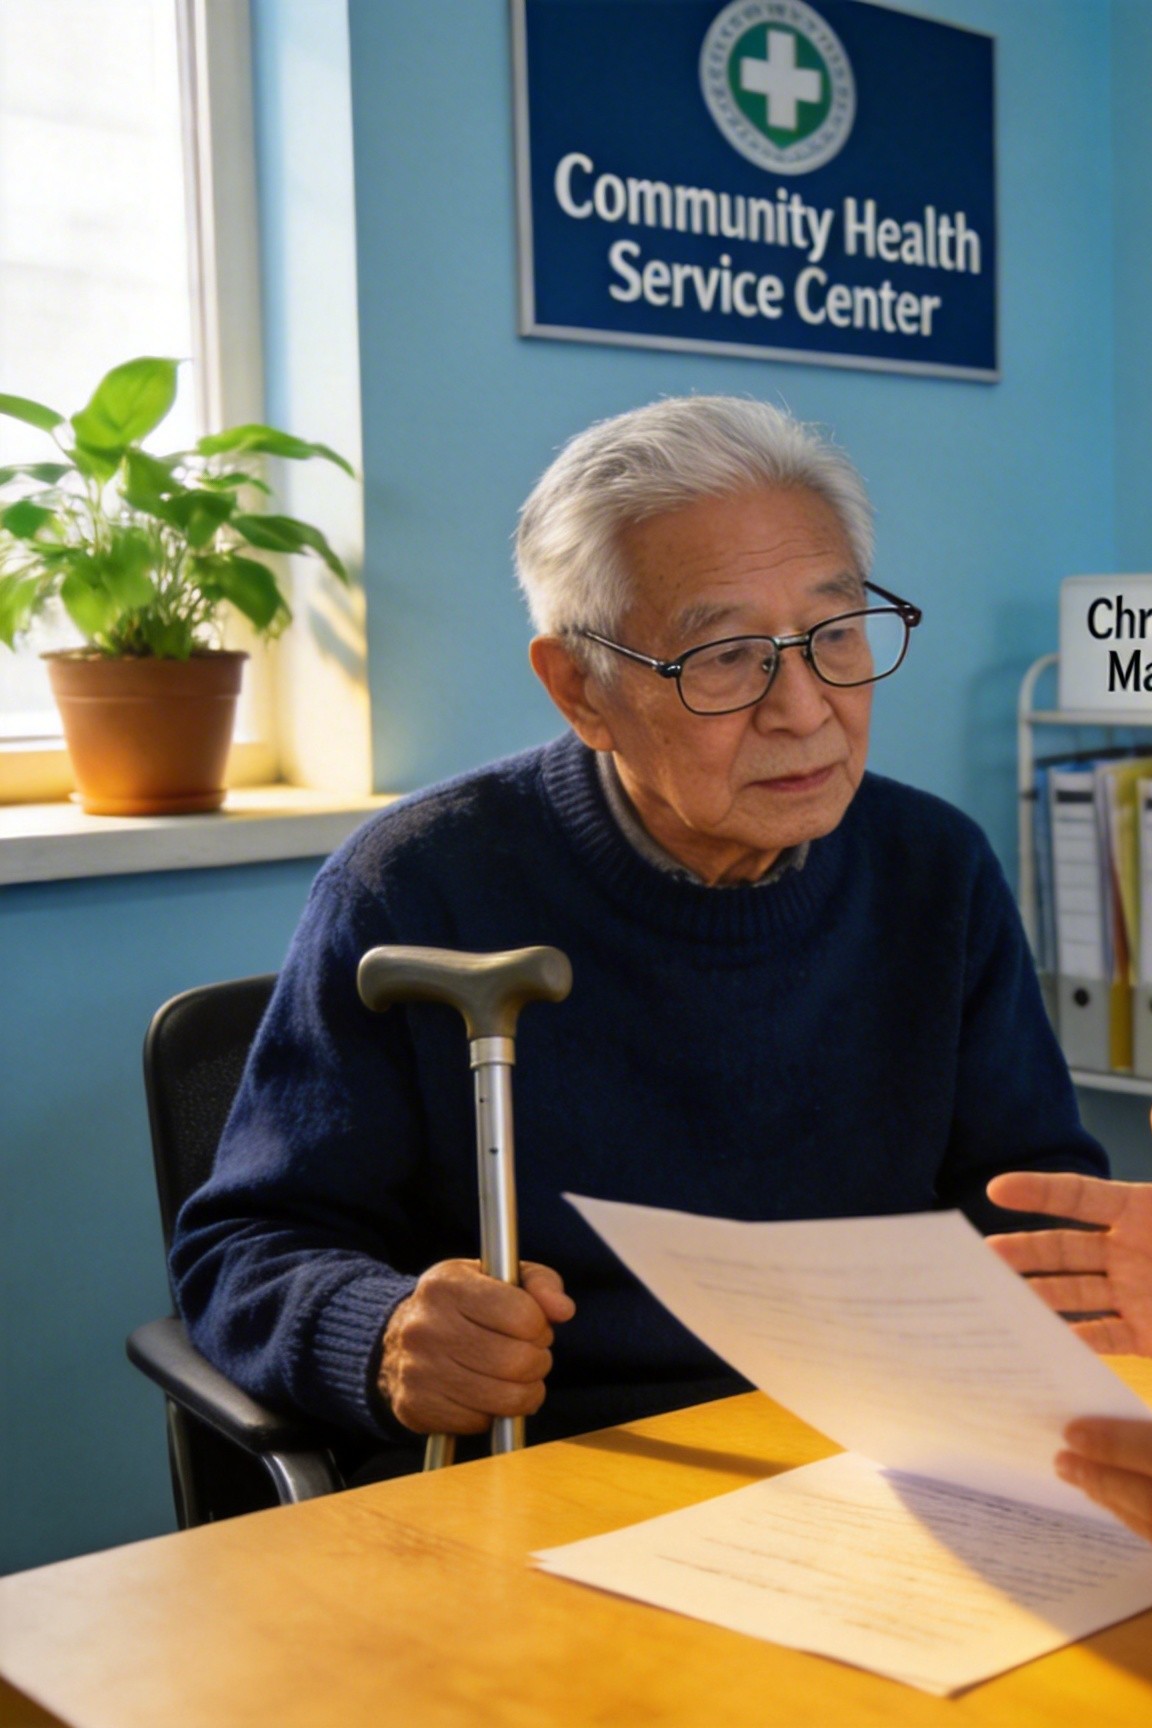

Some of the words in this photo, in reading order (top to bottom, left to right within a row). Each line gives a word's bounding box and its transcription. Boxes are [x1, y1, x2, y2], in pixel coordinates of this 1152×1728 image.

[554, 152, 833, 263] Community
[845, 197, 981, 275] Health
[608, 239, 783, 319] Service
[795, 267, 941, 337] Center
